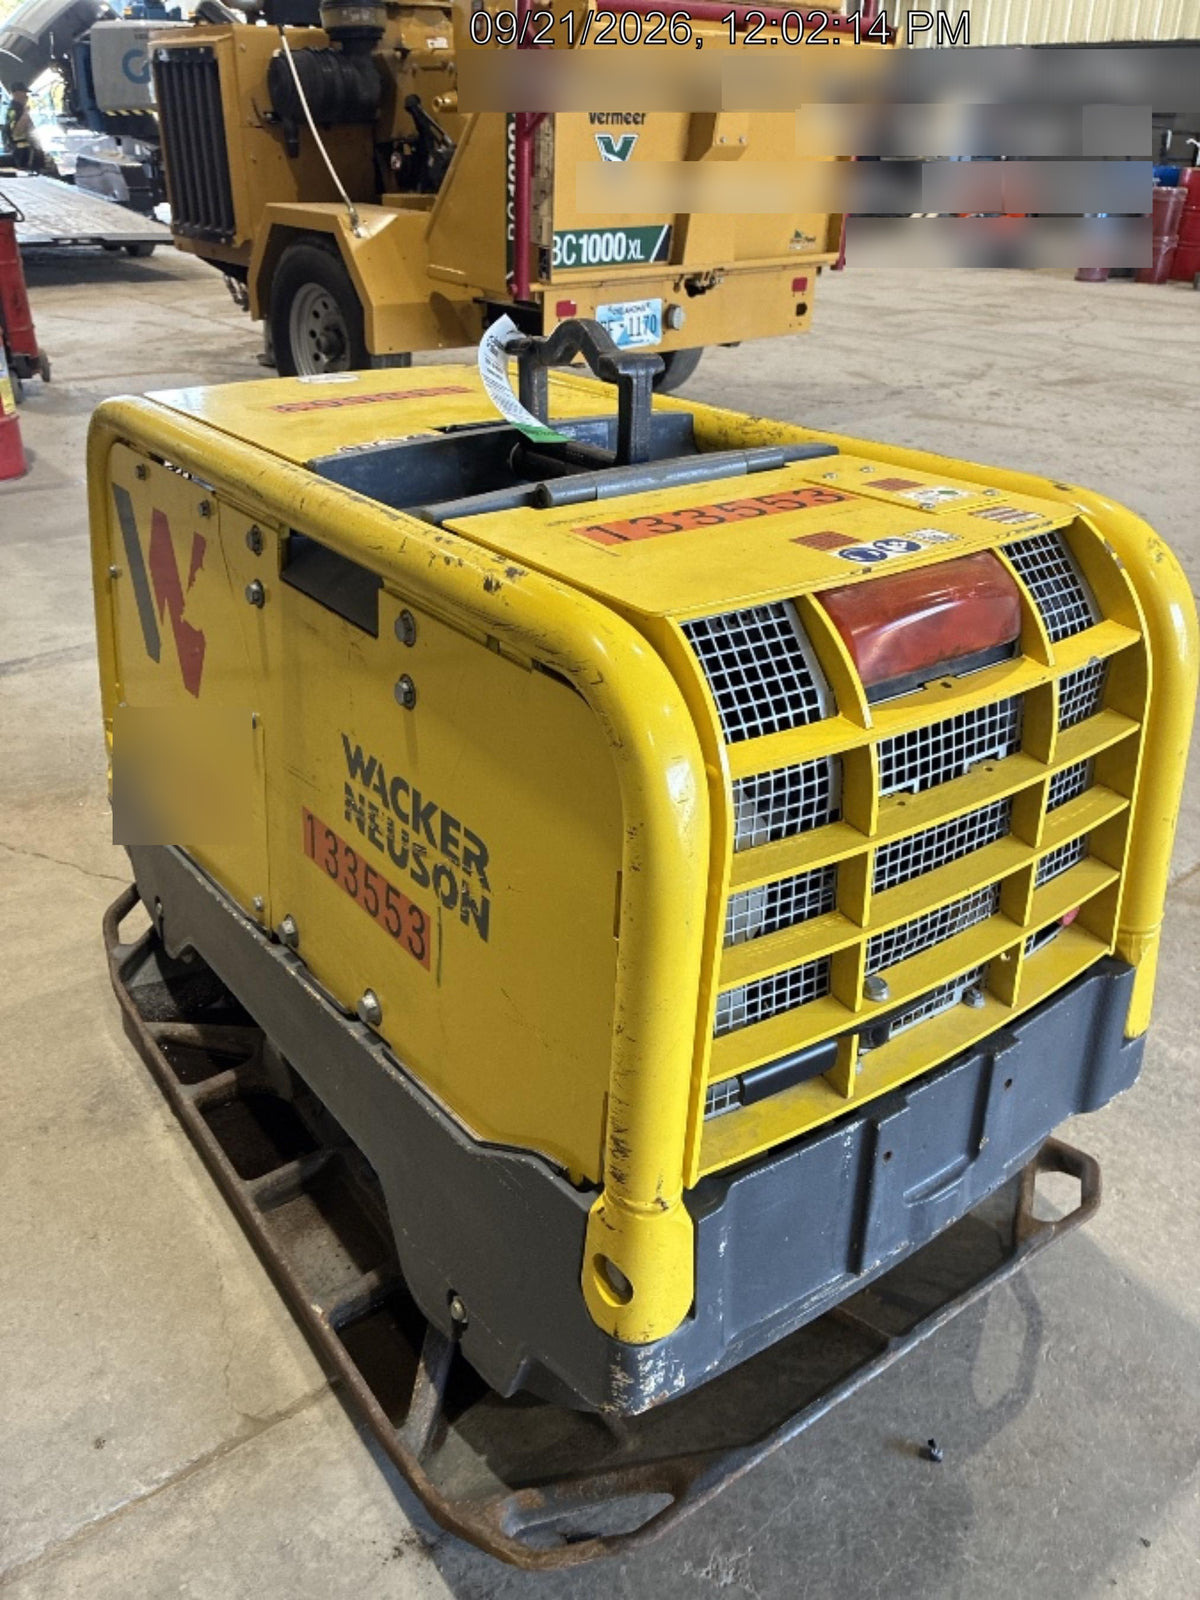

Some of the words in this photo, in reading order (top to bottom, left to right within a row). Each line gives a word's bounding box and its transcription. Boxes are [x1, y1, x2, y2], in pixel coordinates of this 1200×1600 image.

[627, 238, 645, 260] XL
[586, 488, 845, 541] 133553
[340, 732, 491, 892] WACKER
[343, 781, 491, 944] NEUSON
[304, 813, 427, 961] 133553
